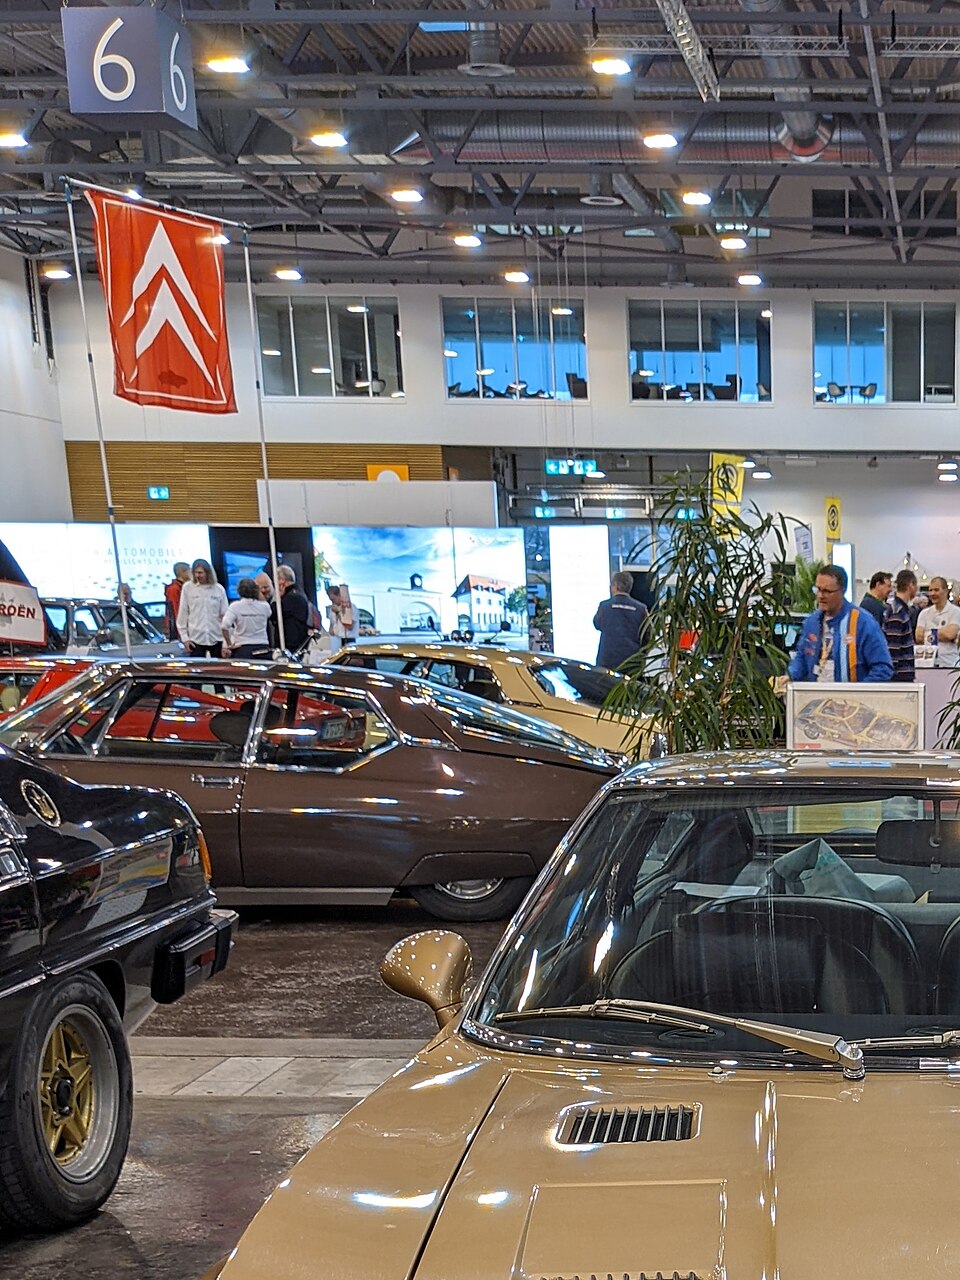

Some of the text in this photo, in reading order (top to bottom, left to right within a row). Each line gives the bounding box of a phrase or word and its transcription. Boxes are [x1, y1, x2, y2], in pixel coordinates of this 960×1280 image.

[93, 17, 136, 102] 6
[169, 32, 187, 111] 6
[107, 547, 183, 557] ATOMOBIL
